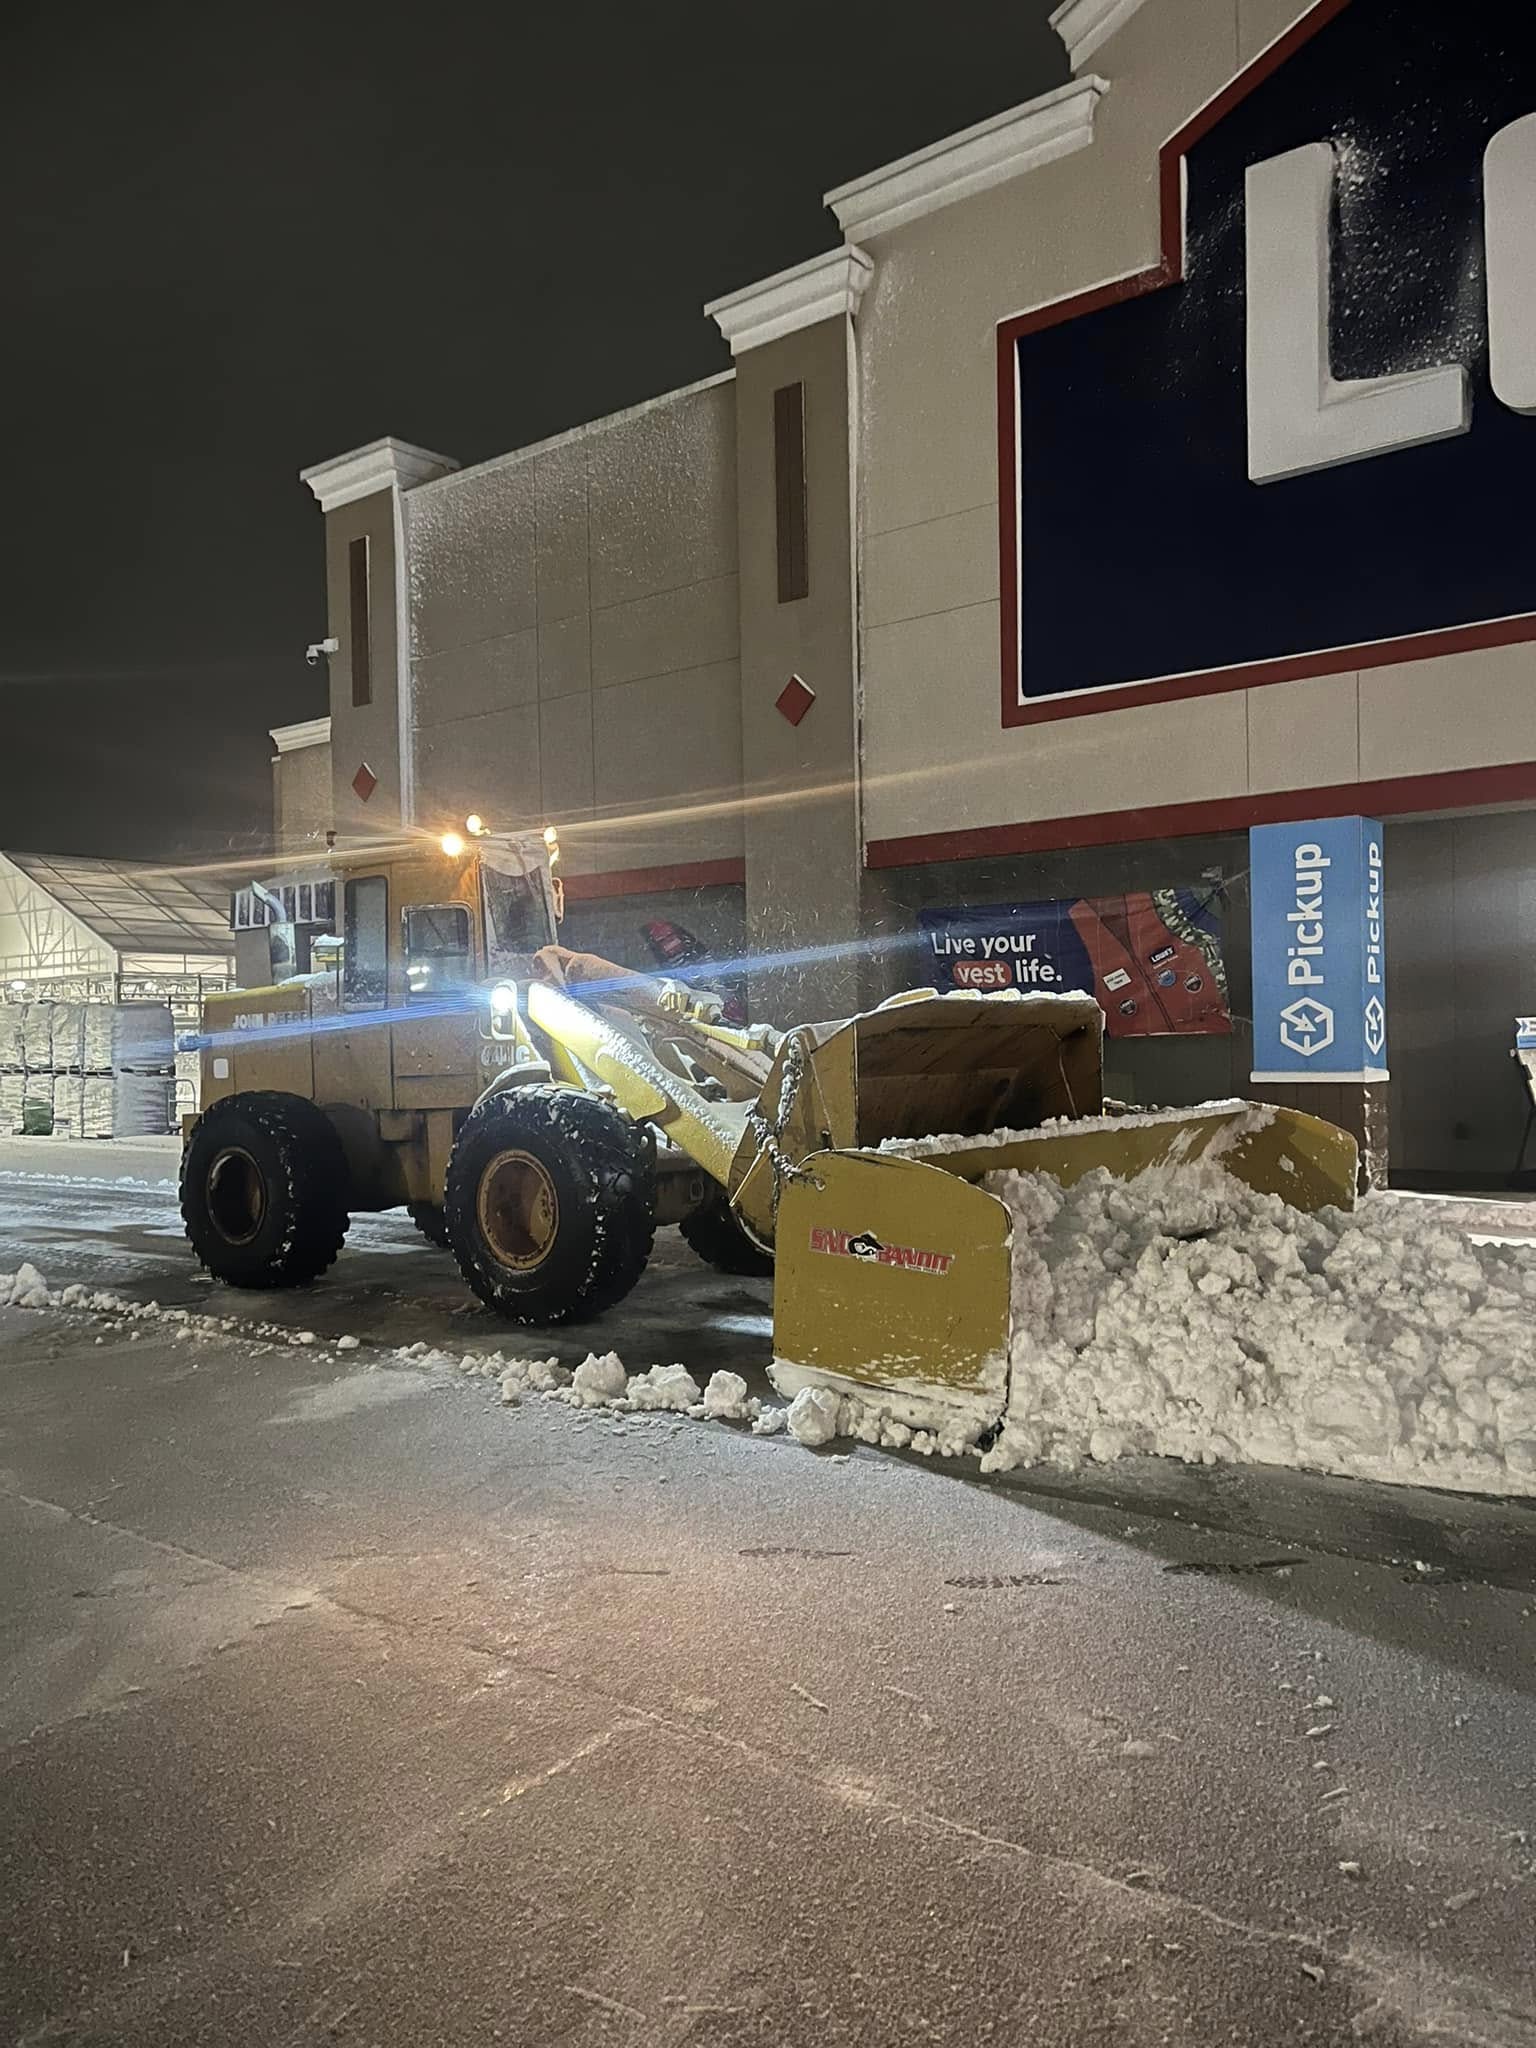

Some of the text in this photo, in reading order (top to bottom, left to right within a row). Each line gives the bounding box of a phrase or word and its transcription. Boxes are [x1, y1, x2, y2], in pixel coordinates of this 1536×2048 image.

[1246, 112, 1536, 485] L
[931, 932, 1037, 959] Live your
[957, 958, 1063, 984] vest life.
[1286, 843, 1331, 985] Pickup
[1366, 841, 1382, 984] Pickup
